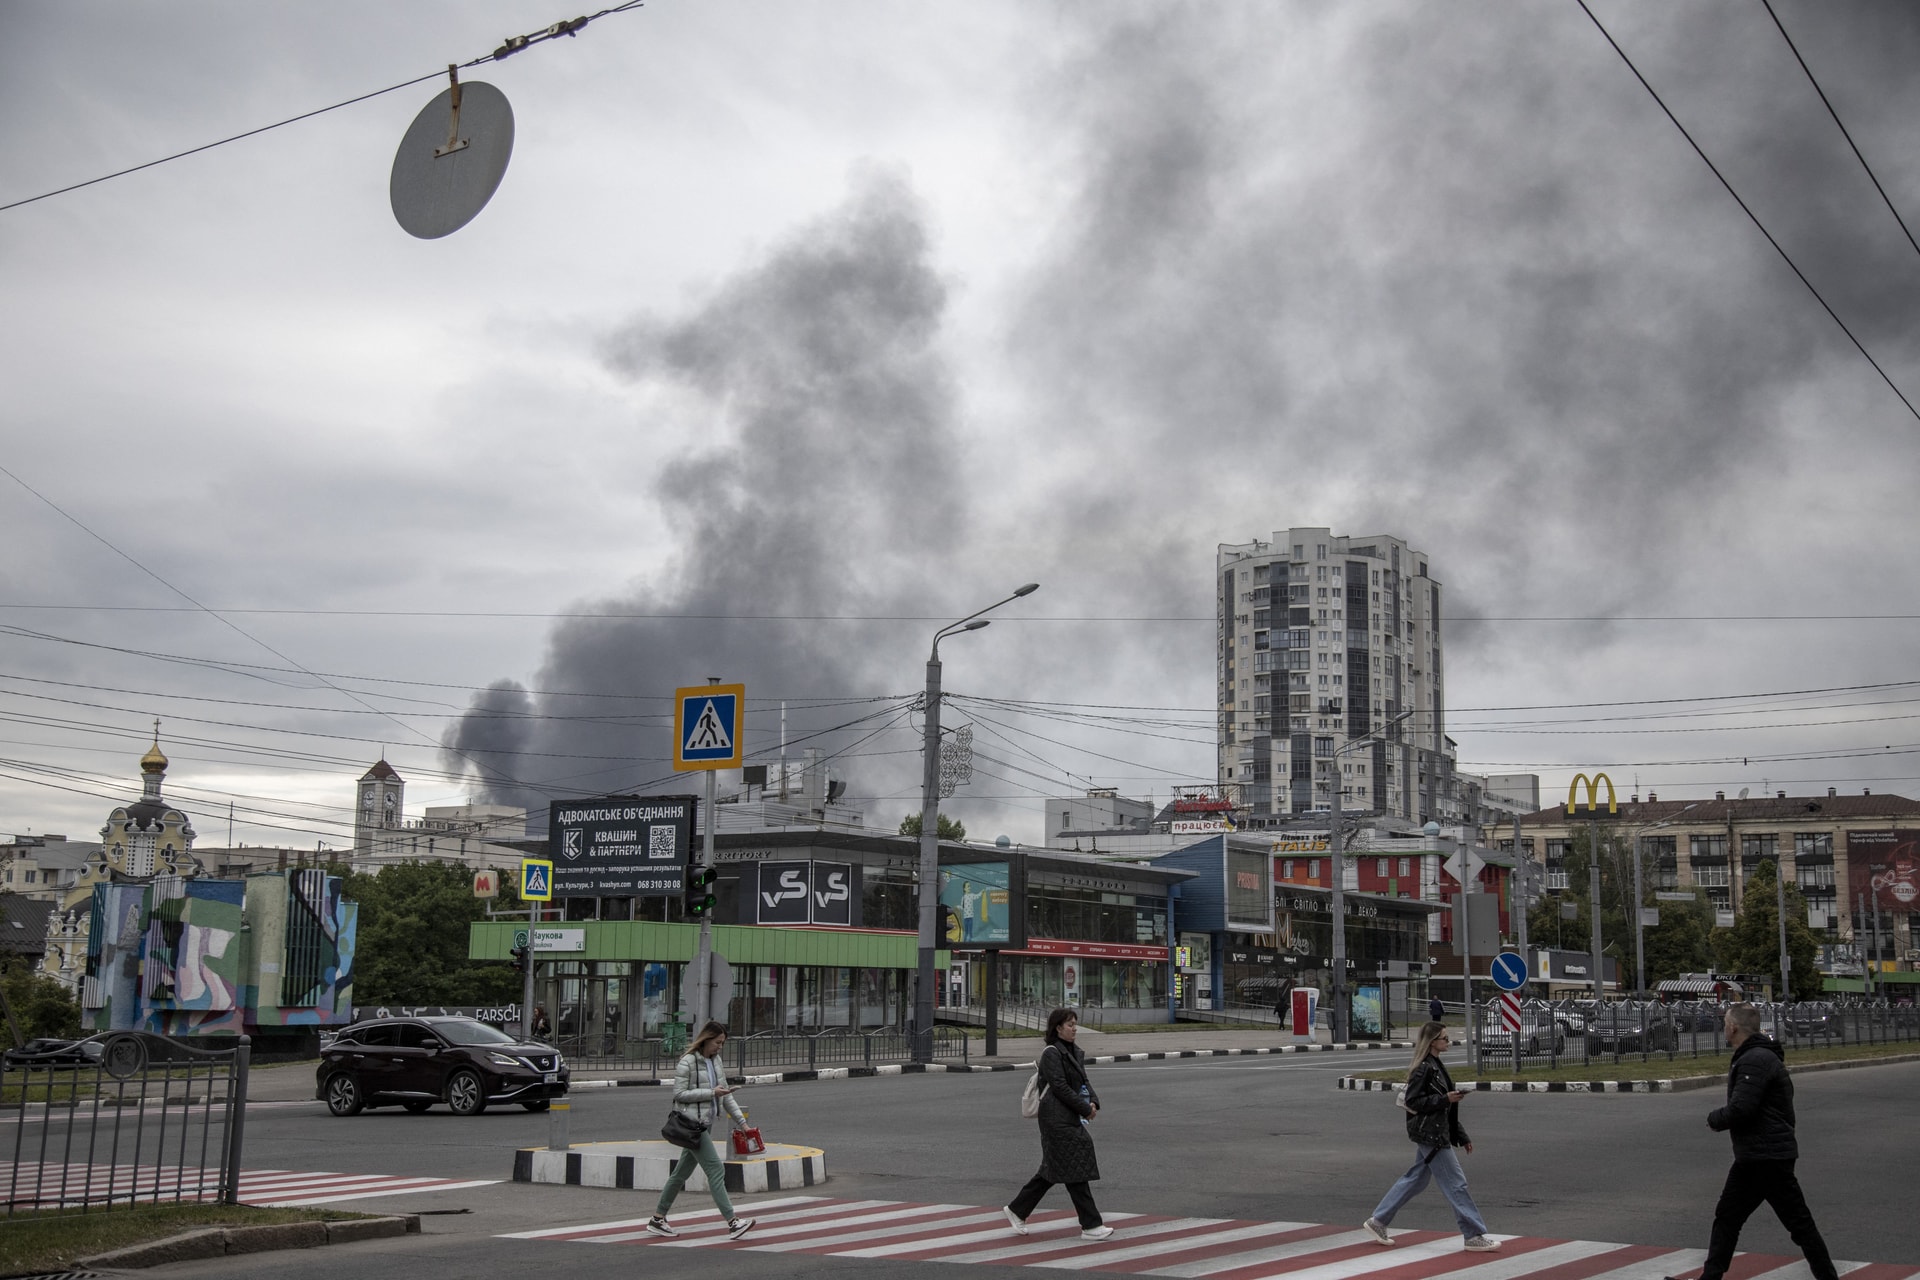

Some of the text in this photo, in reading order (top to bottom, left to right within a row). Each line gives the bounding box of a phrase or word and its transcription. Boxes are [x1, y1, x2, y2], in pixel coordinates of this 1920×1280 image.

[558, 806, 684, 825] АДВОКАТСЬКЕ ОБ'ЄДНАННЯ
[1174, 820, 1226, 832] працюєм
[595, 830, 637, 843] КВАШИН
[589, 845, 642, 857] & ПАРТНЕРИ
[694, 850, 772, 861] TRRITORY
[608, 866, 629, 874] запорука
[600, 881, 632, 890] kvashyn.com
[637, 880, 681, 889] 068 310 30 08
[1294, 899, 1319, 912] СВІТЛО
[1358, 905, 1378, 919] ДЕКОР
[475, 1003, 521, 1022] FARSCH
